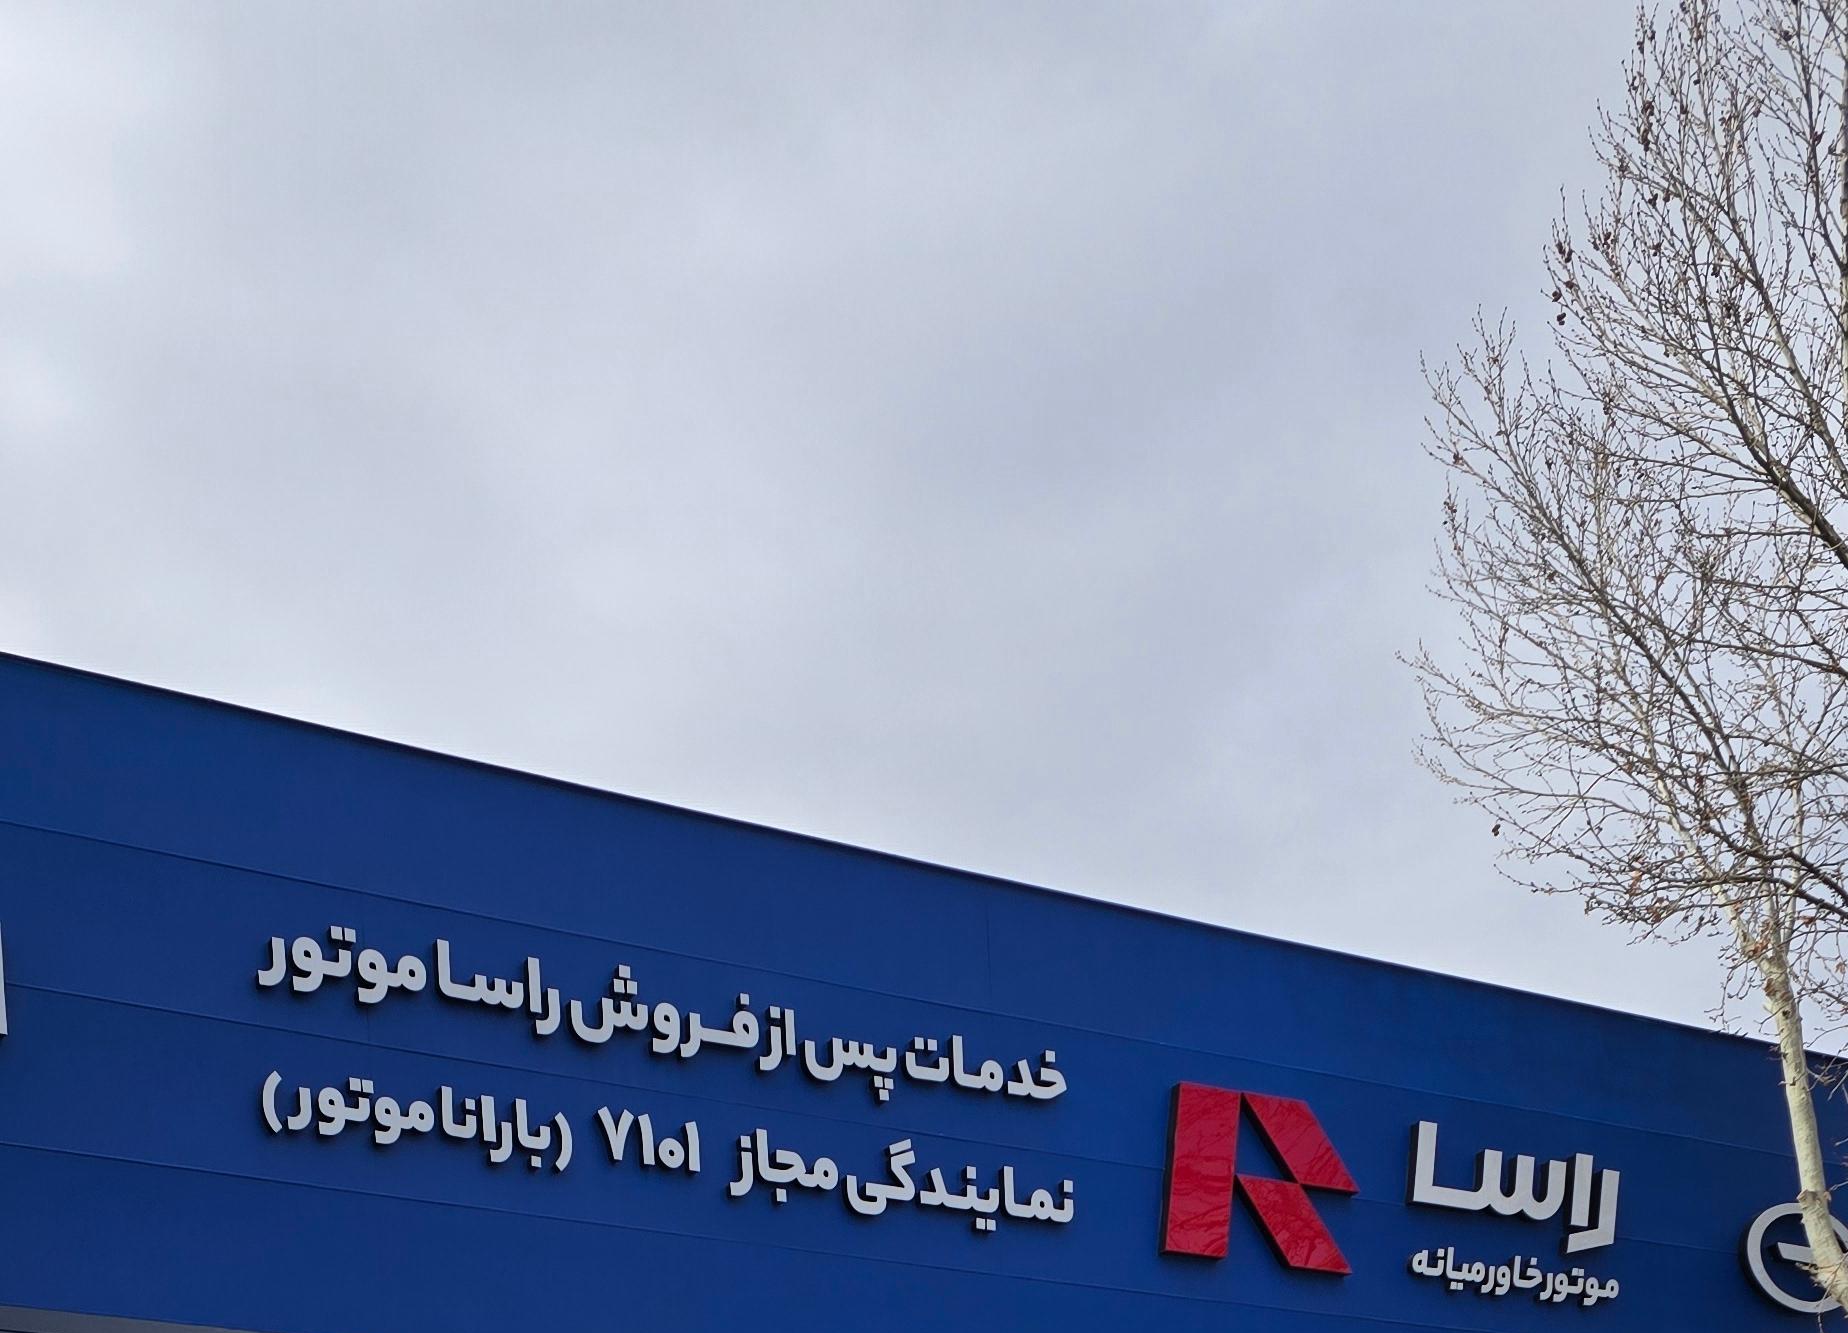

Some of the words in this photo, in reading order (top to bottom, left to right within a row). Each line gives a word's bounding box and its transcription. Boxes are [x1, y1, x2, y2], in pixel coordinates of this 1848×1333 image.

[570, 964, 761, 1058] فروش
[759, 1005, 797, 1071] از
[804, 1037, 897, 1101] پس
[905, 1035, 1067, 1099] خدمات
[597, 1106, 701, 1172] ۷۱۰۱
[729, 1128, 839, 1203] مجاز
[846, 1138, 1074, 1231] نمایندگی
[1412, 1120, 1620, 1254] راسا
[1539, 1267, 1620, 1306] موتور
